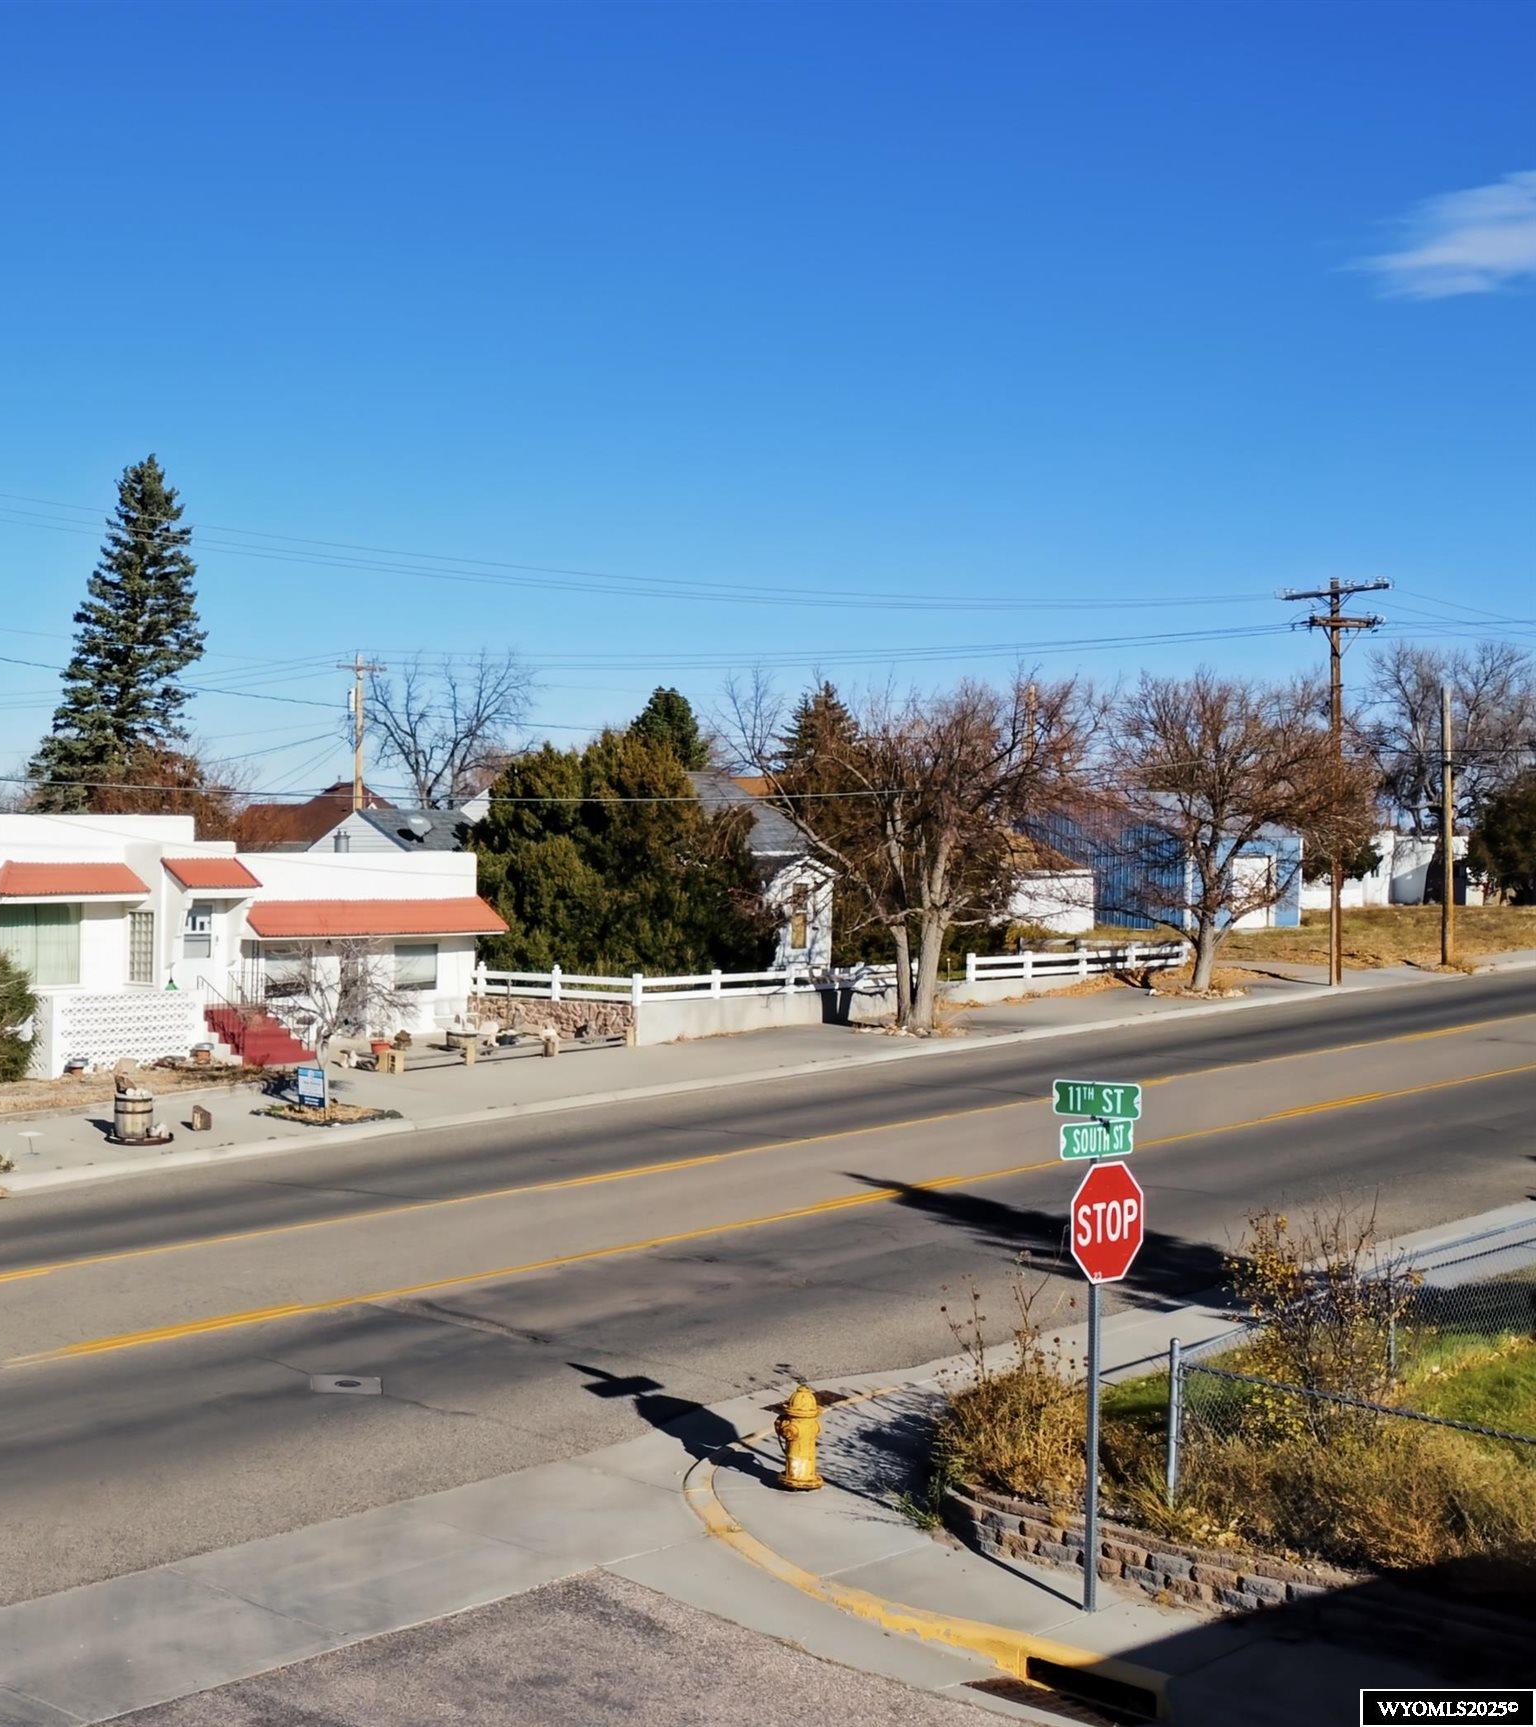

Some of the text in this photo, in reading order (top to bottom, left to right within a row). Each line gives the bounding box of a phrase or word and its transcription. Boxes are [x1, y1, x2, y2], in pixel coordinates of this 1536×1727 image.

[1068, 1086, 1124, 1114] 11TH ST
[1073, 1125, 1124, 1153] SOUTH ST
[1077, 1199, 1138, 1247] STOP
